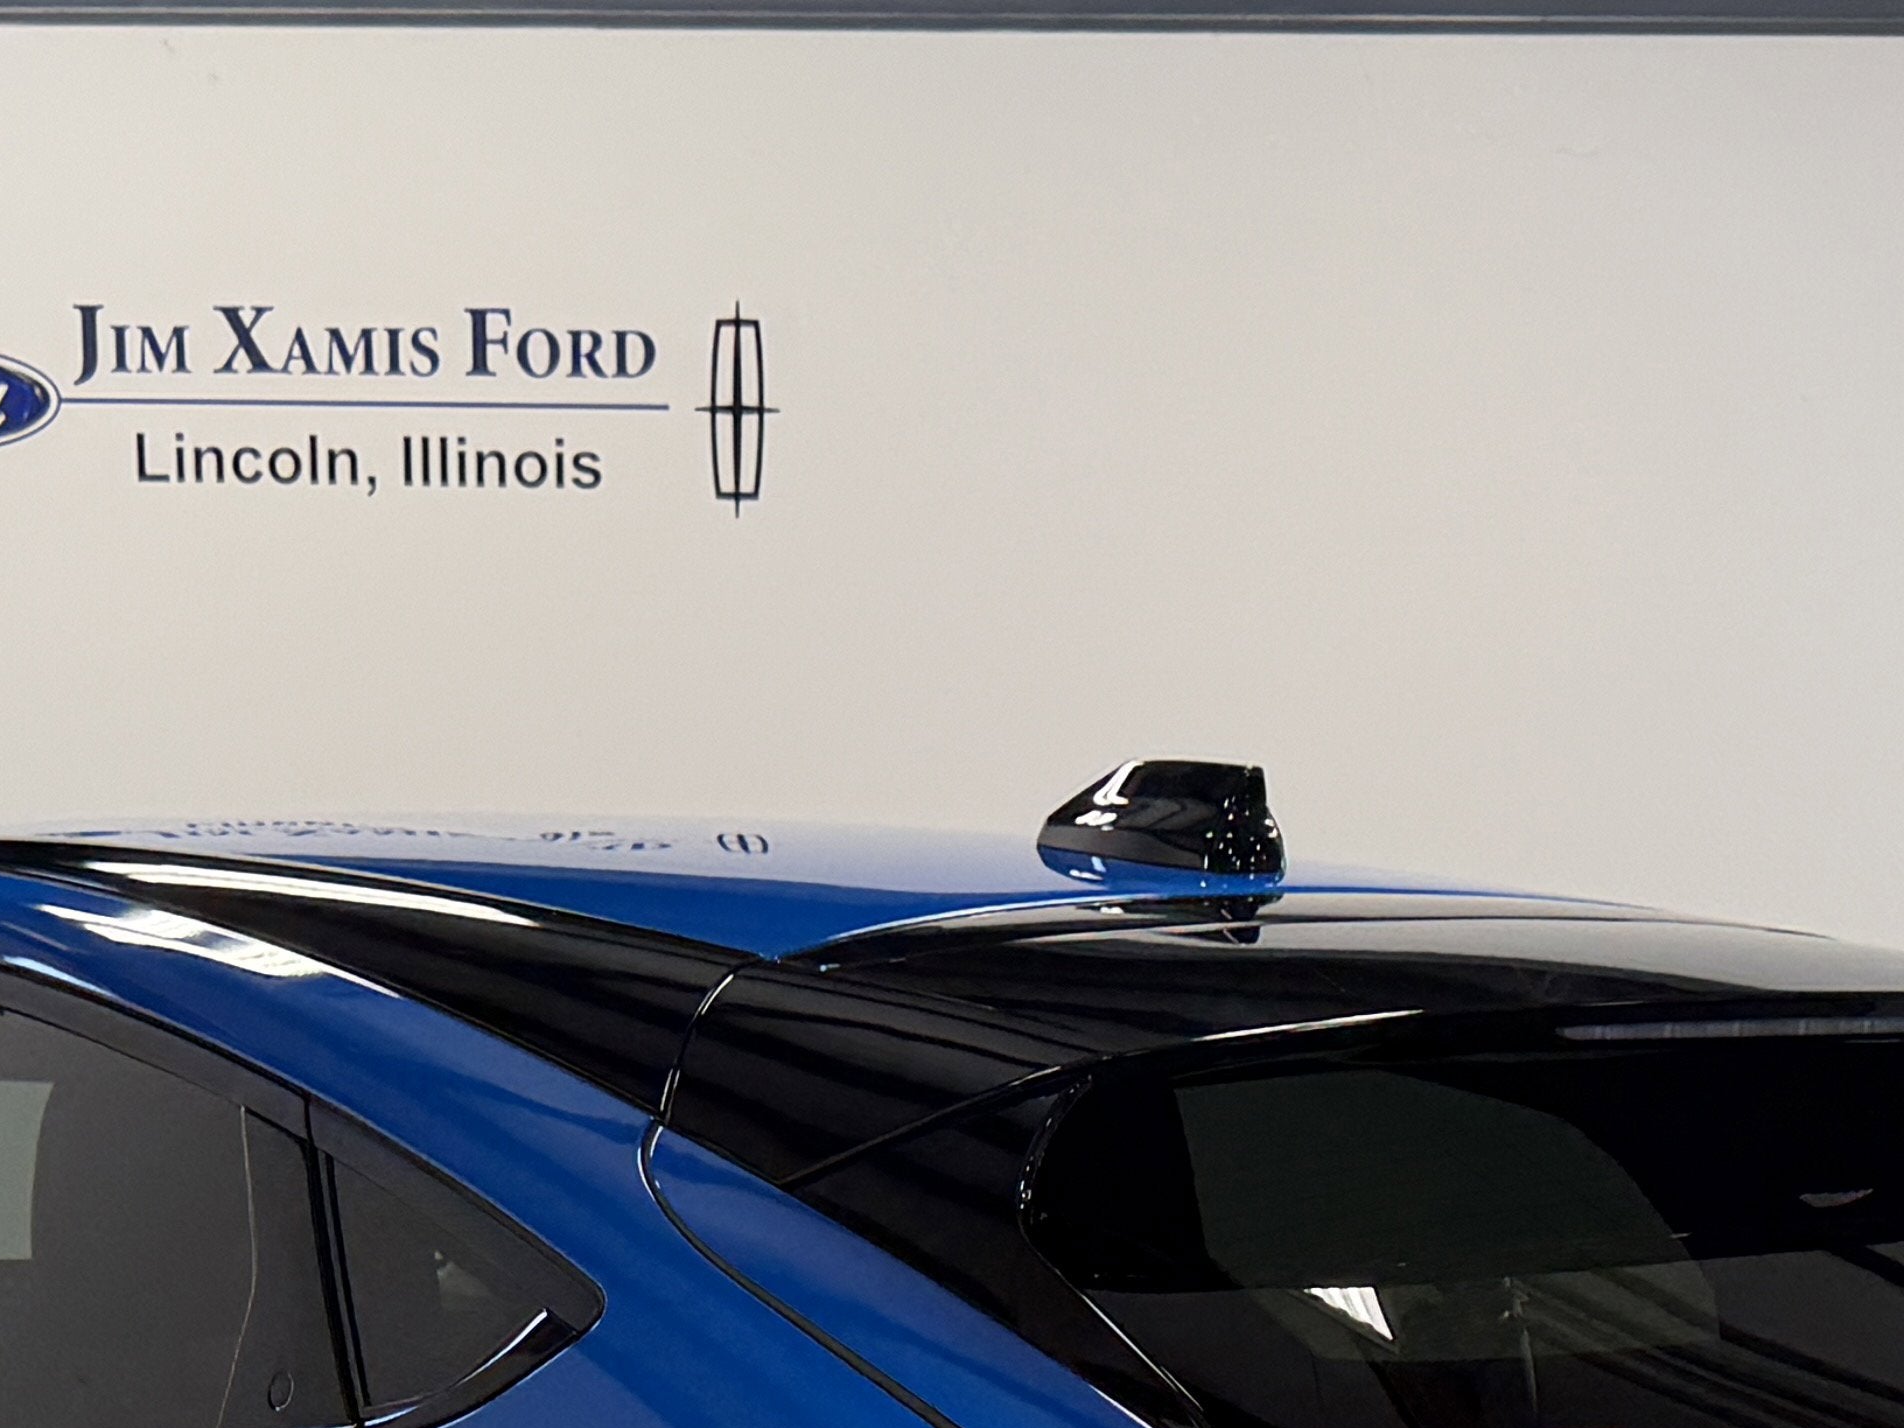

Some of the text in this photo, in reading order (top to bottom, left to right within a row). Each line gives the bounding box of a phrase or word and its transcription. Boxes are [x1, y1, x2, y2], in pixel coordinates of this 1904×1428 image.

[73, 304, 656, 386] JIM XAMIS FORD
[136, 432, 602, 497] Lincoln, Illinois
